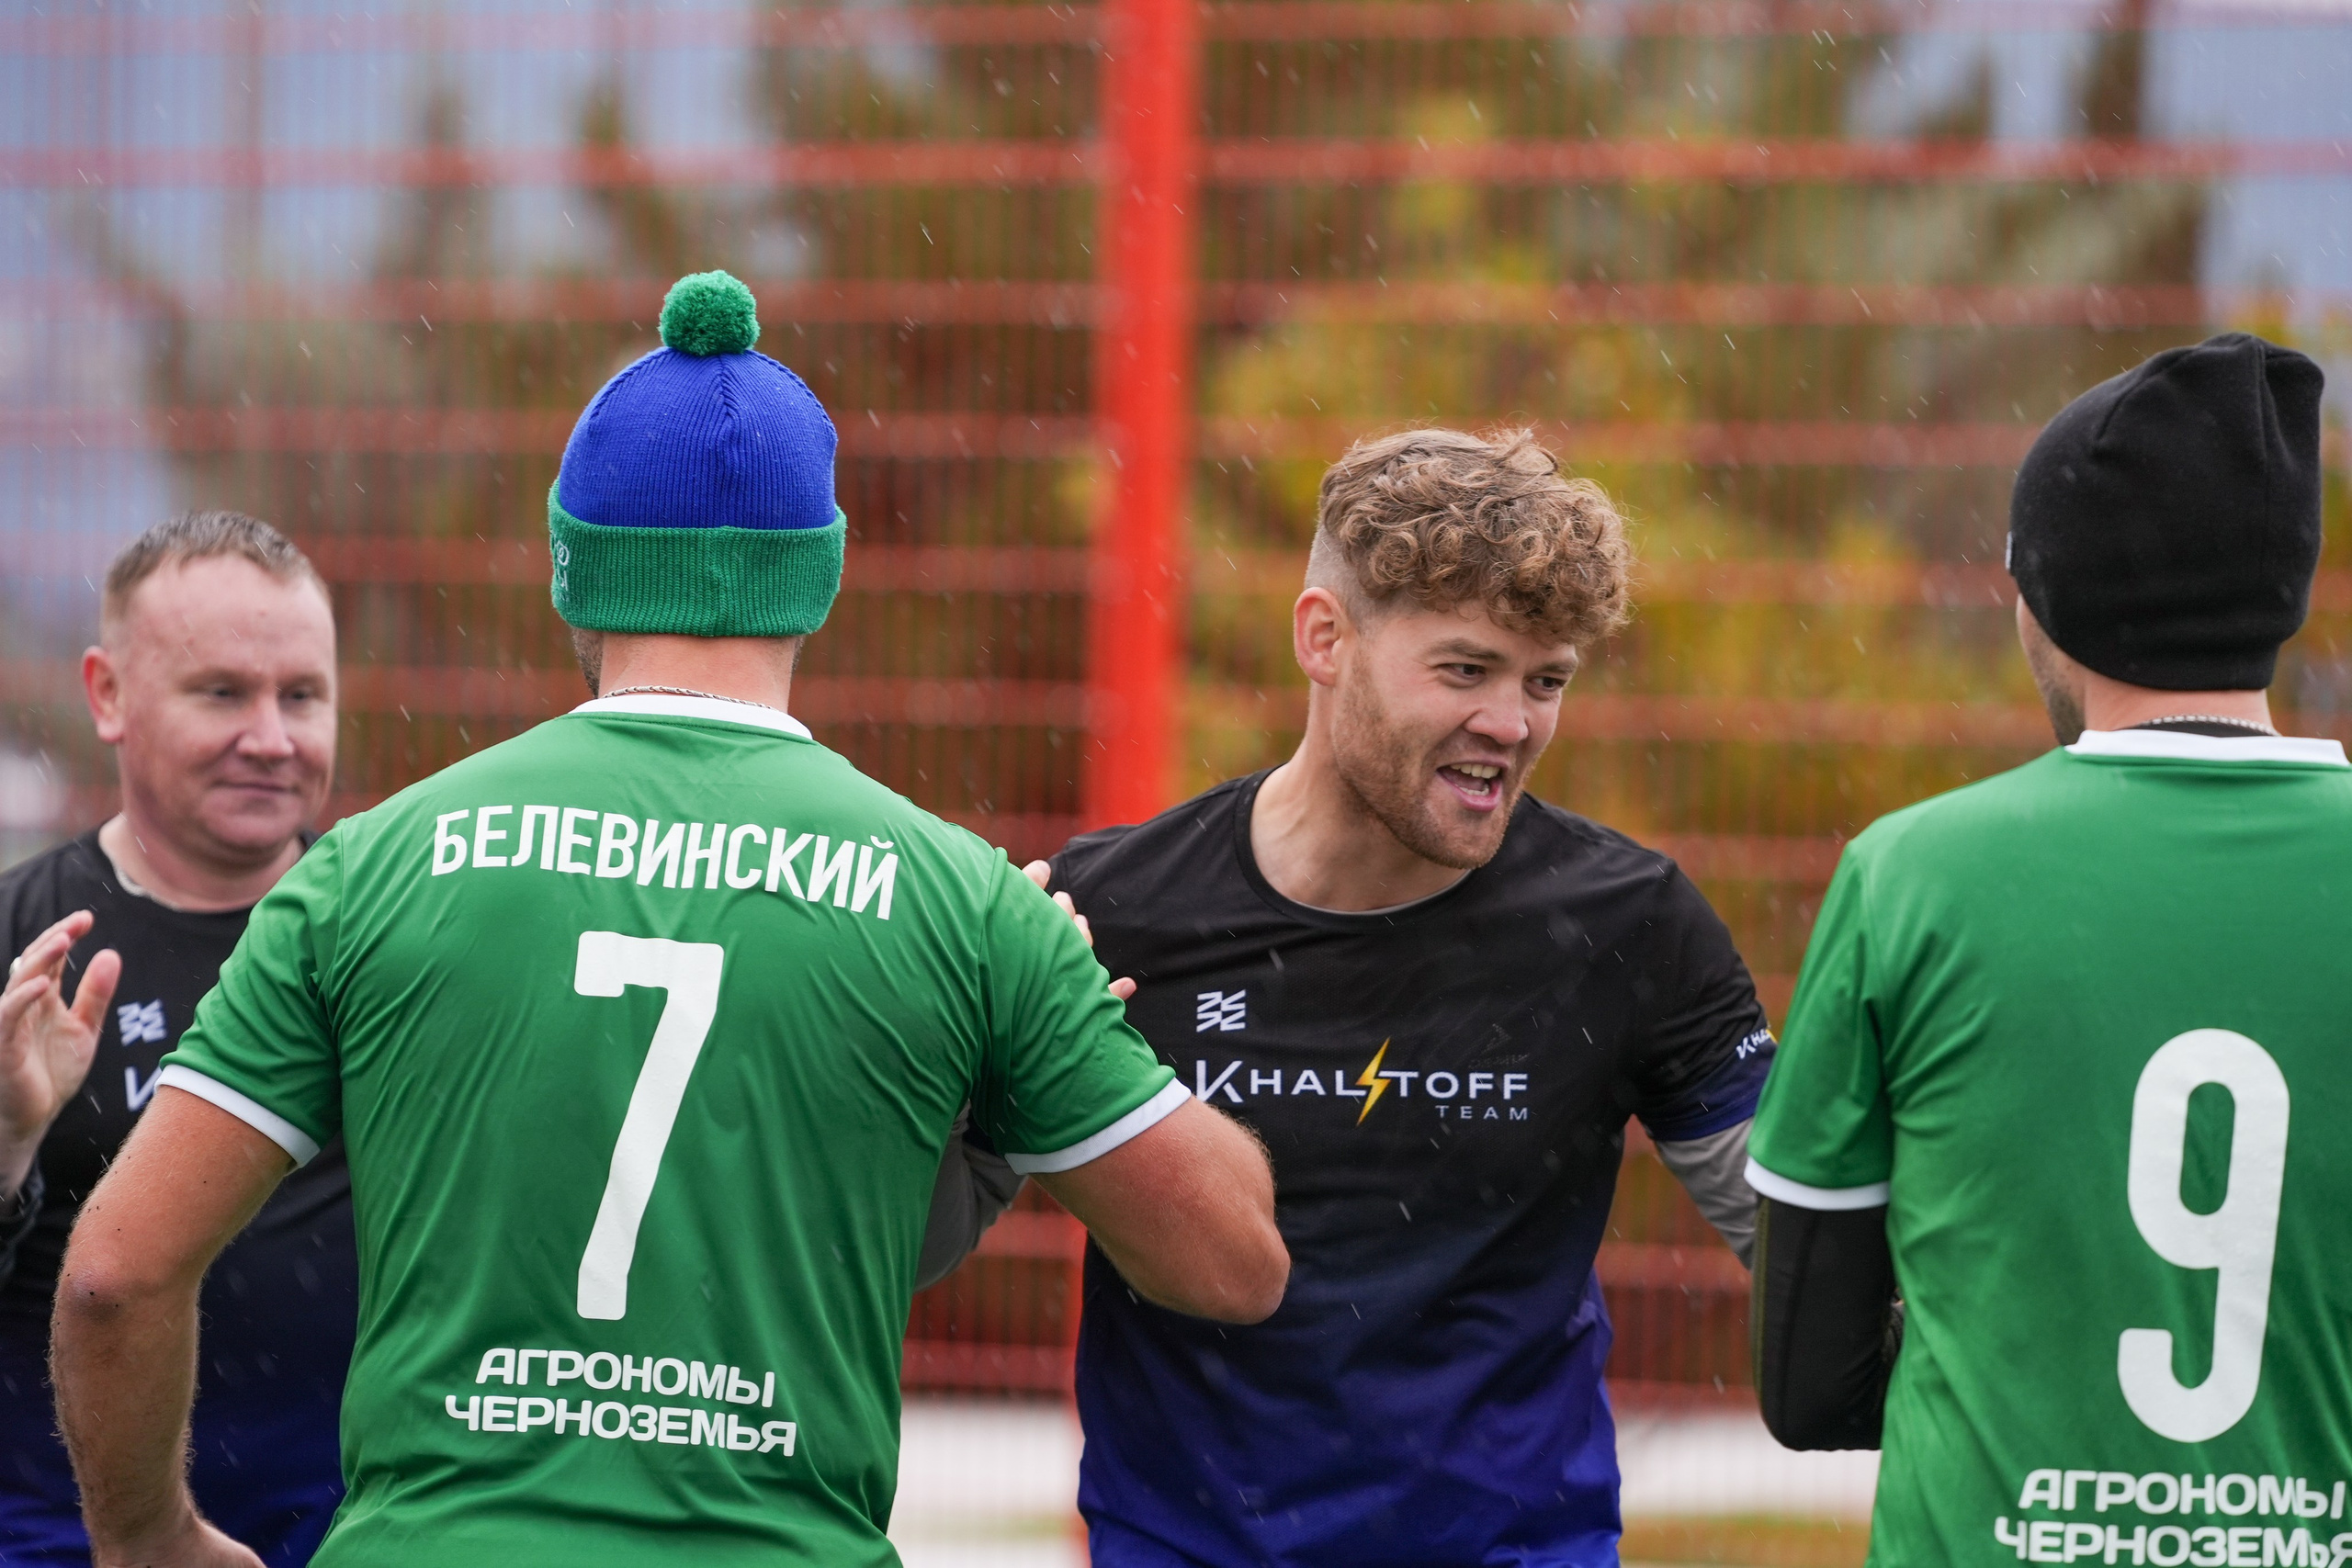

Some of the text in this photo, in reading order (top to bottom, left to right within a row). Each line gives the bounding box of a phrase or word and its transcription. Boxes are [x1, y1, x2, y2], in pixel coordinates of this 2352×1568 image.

[432, 805, 899, 919] БЕЛЕВИНСКИЙ
[574, 931, 724, 1320] 7
[1435, 1105, 1528, 1120] TEAM
[2118, 1028, 2290, 1442] 9
[475, 1348, 775, 1408] АГРОНОМЫ
[445, 1394, 797, 1457] ЧЕРНОЗЕМЬЯ
[2018, 1468, 2346, 1519] АГРОНОМЫ
